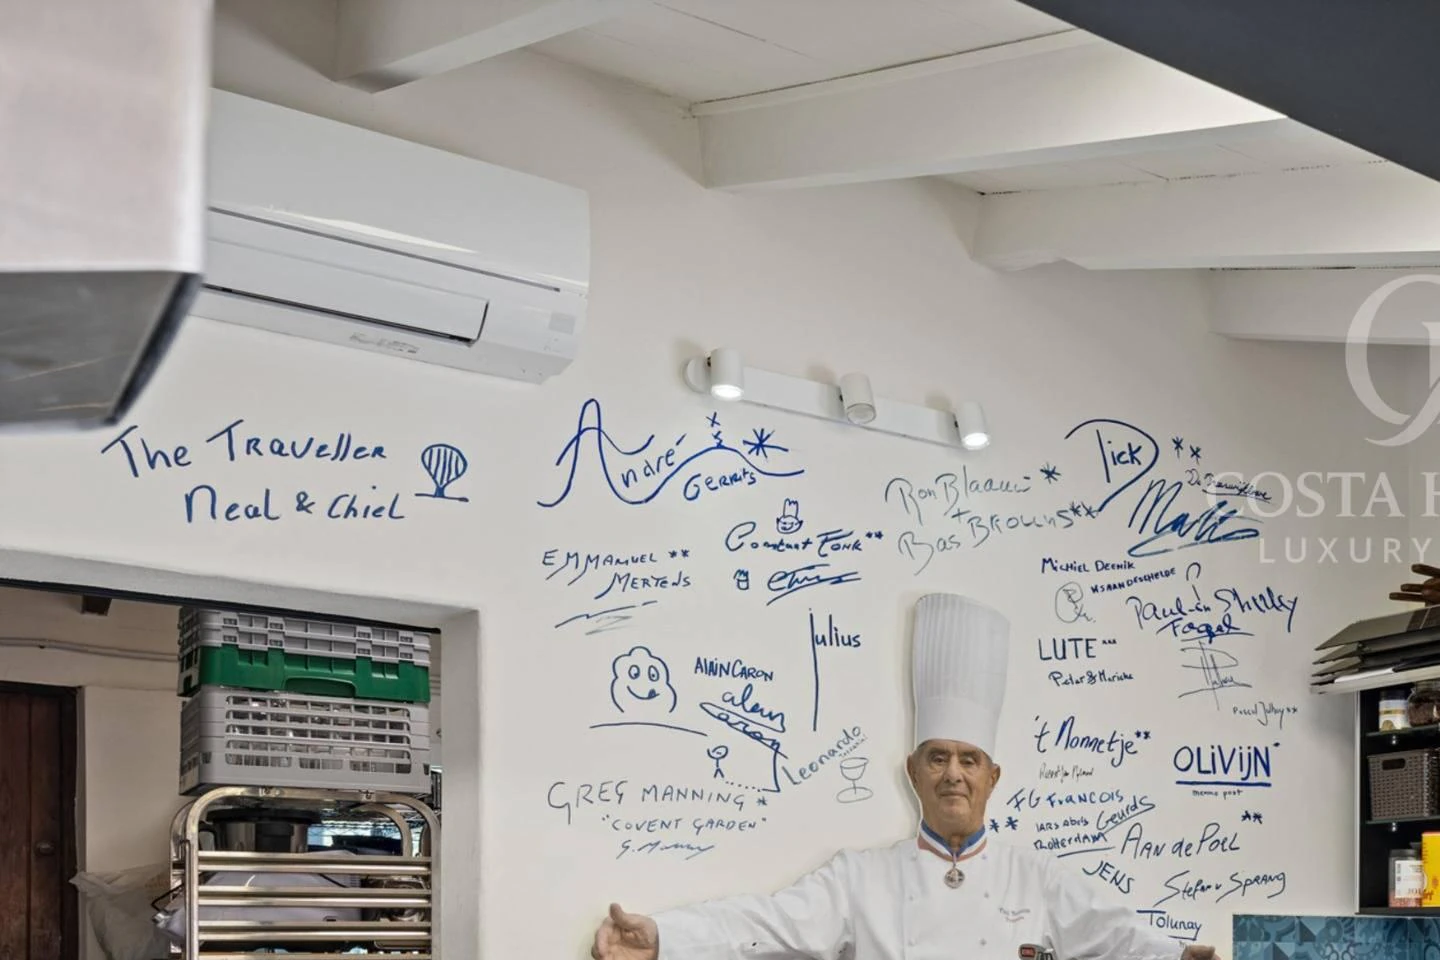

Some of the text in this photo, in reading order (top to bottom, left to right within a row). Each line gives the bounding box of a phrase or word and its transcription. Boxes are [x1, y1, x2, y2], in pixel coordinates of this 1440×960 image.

[101, 425, 192, 477] The
[1064, 418, 1160, 512] Dick
[295, 491, 316, 514] &
[898, 530, 961, 576] Bas
[1038, 637, 1098, 661] LUTE
[782, 726, 862, 785] Leonardo
[548, 781, 745, 825] GREG MANNING
[1082, 860, 1135, 895] JENS
